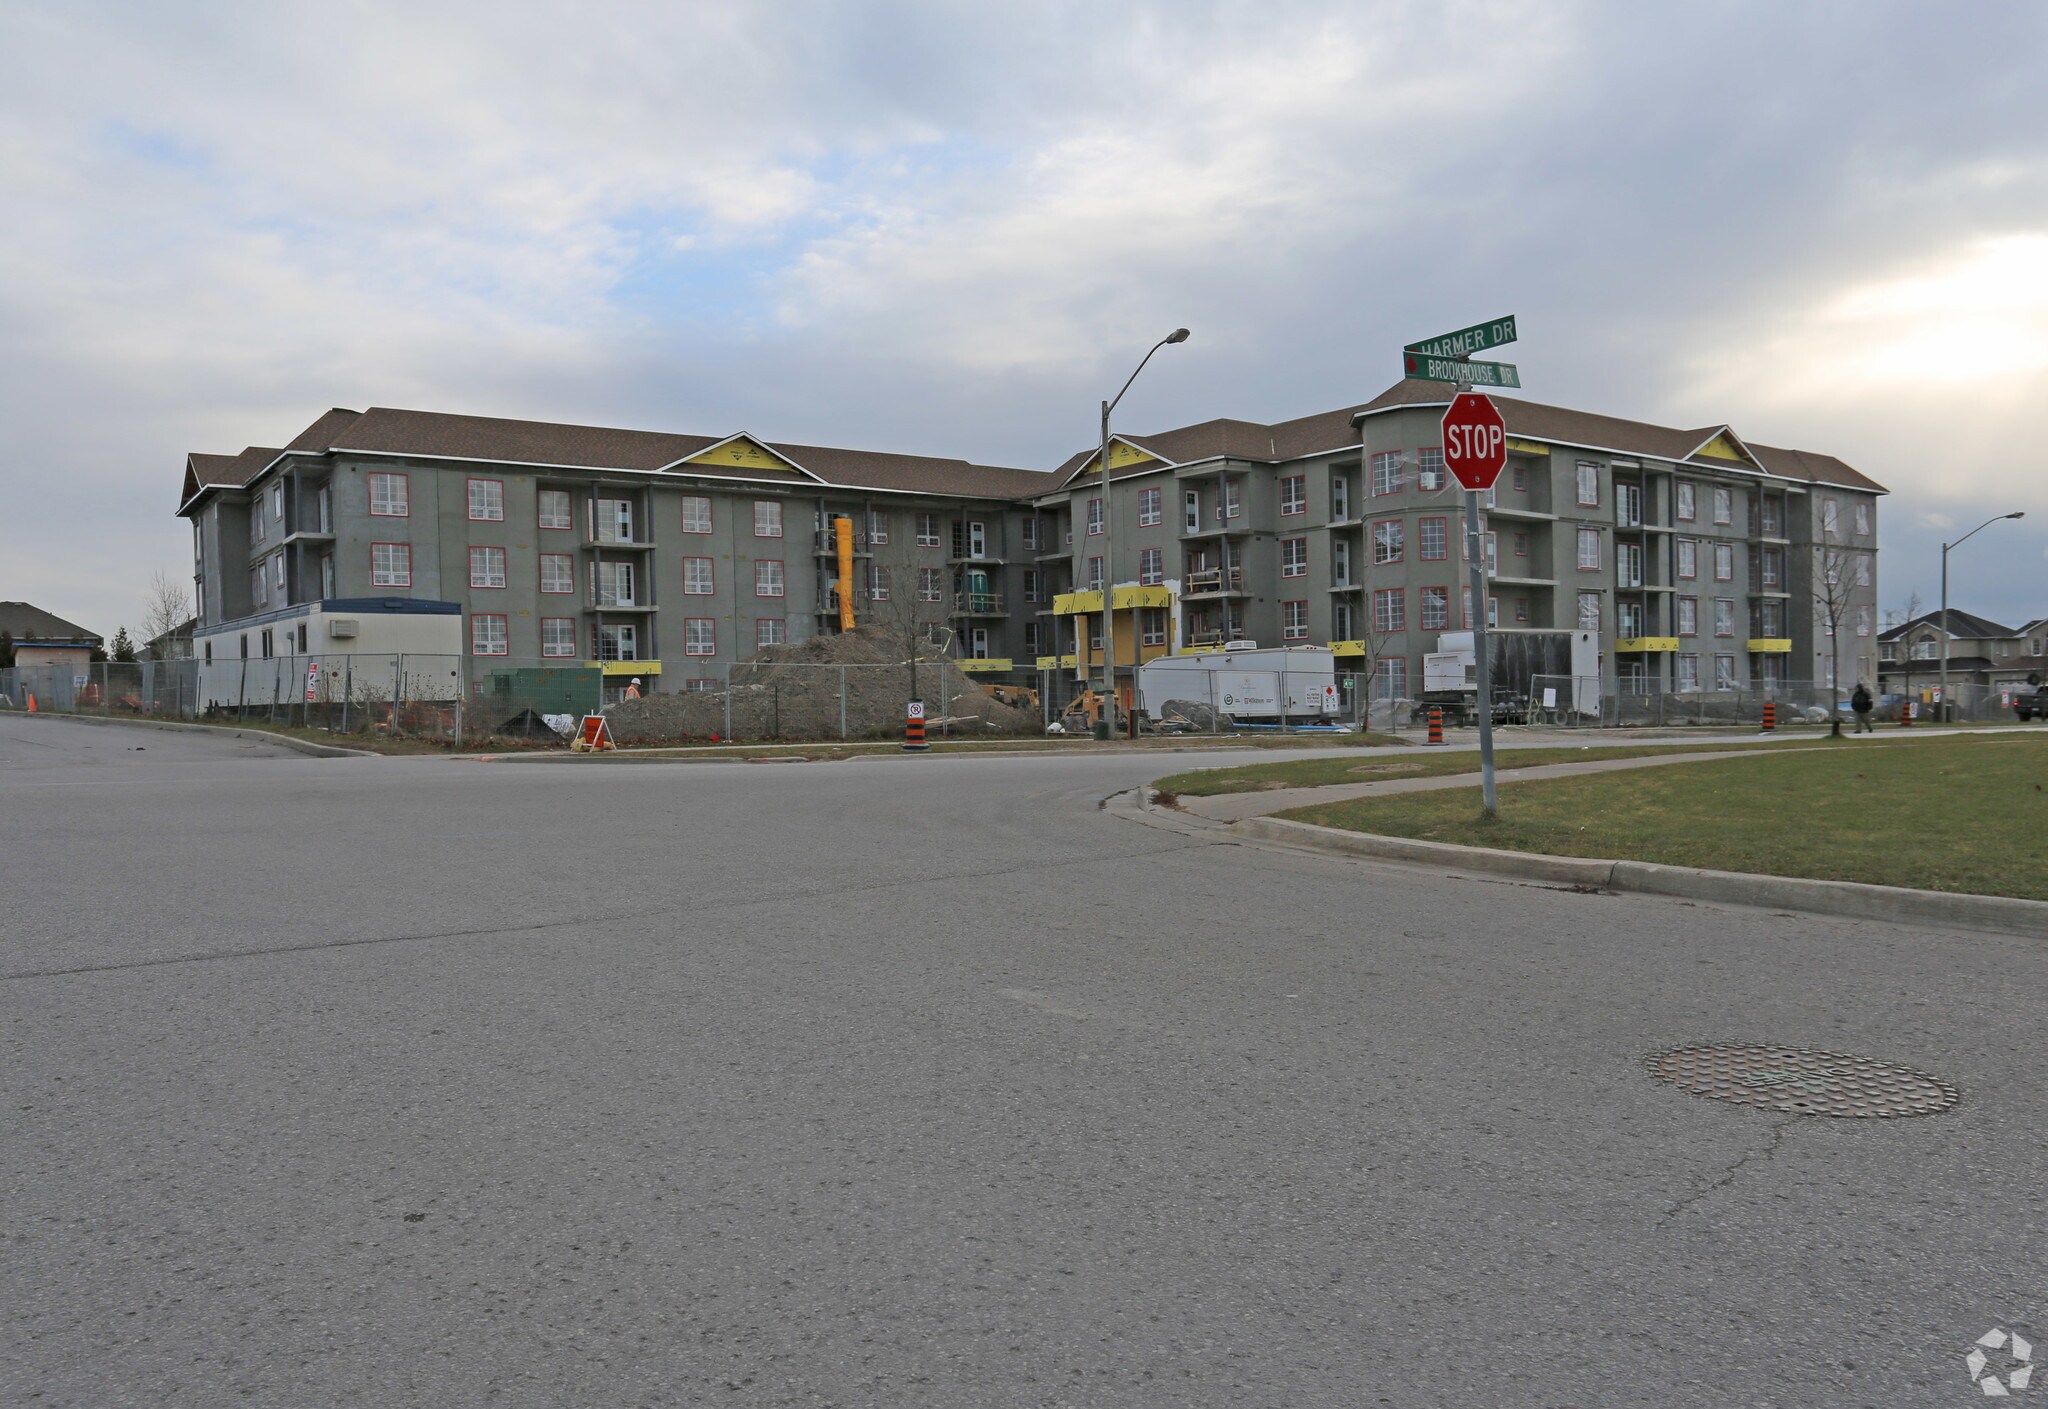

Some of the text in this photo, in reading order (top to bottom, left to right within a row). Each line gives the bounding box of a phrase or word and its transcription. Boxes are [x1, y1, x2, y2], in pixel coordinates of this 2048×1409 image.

[1422, 321, 1513, 356] HARMER DR
[1428, 360, 1513, 384] BROOKHOUSE DR
[1449, 424, 1501, 459] STOP
